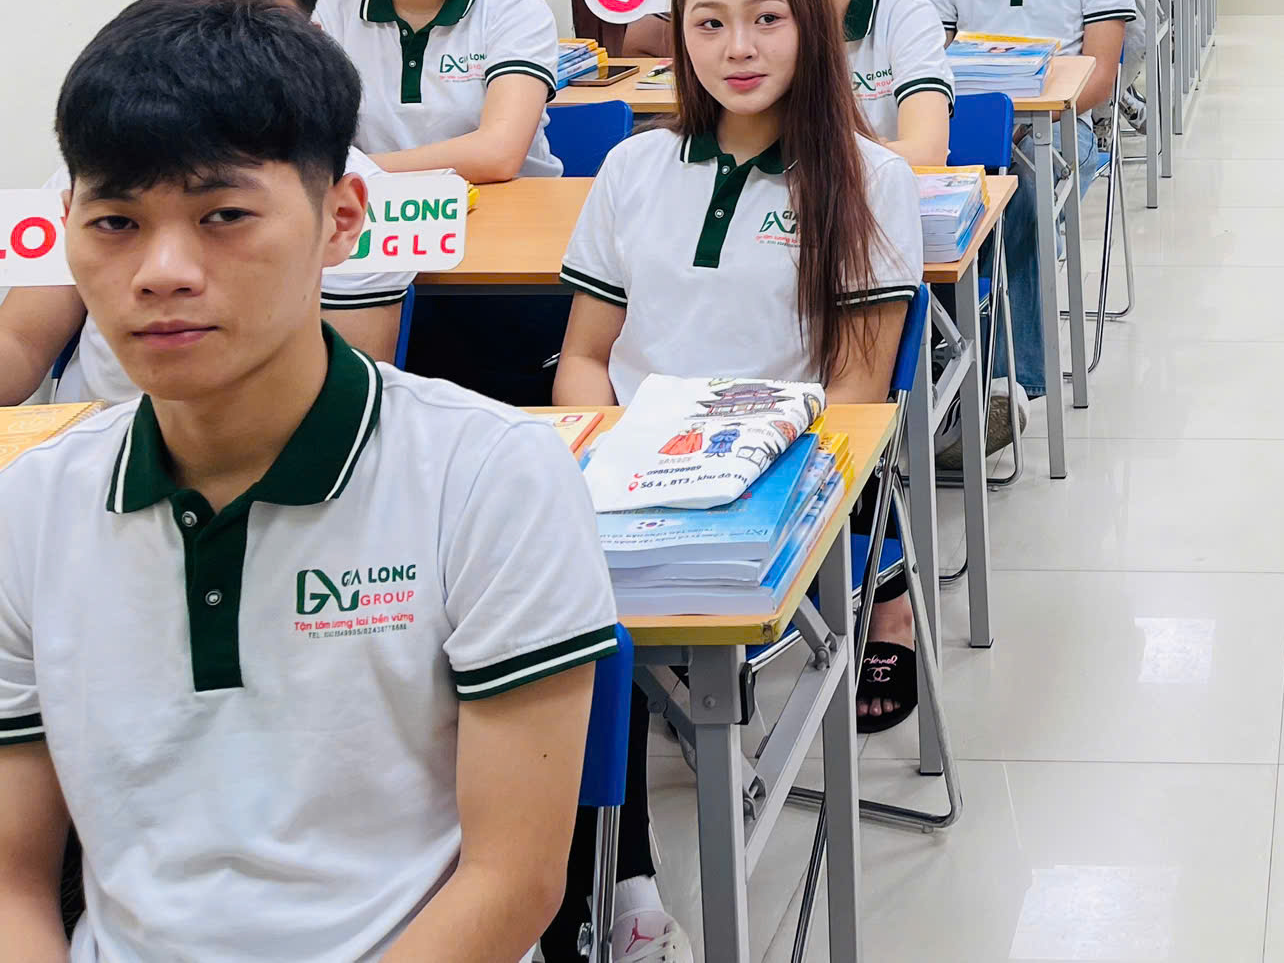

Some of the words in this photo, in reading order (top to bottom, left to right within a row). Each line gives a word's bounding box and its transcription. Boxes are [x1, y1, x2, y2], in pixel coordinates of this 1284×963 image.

[384, 198, 458, 221] LONG
[366, 564, 416, 583] LONG
[360, 590, 415, 606] GROUP
